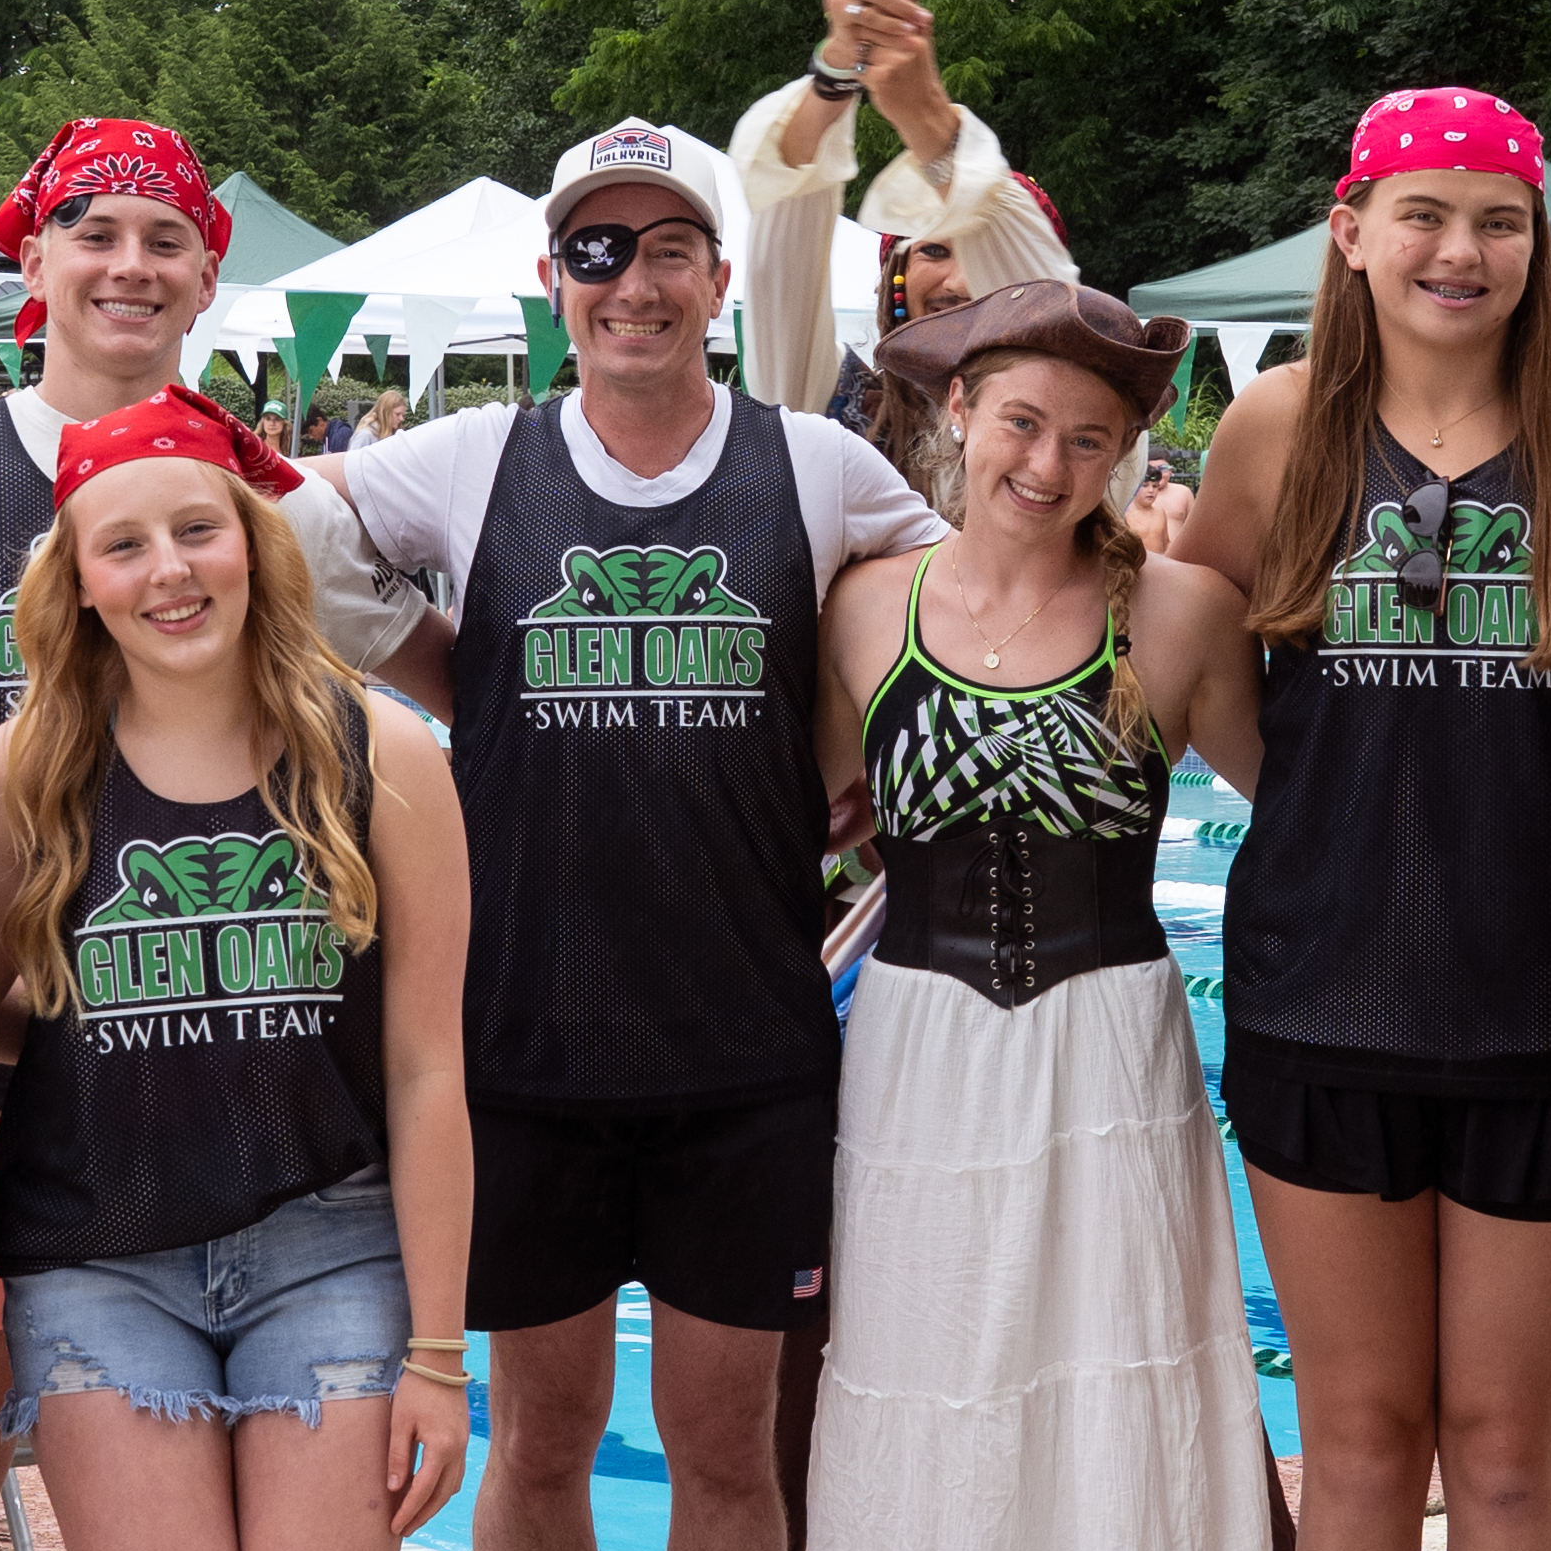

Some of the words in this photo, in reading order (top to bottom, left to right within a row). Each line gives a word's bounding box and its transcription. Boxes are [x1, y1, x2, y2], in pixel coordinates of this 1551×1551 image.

[596, 149, 666, 166] VALKYRIES
[1323, 583, 1434, 645] GLEN
[1447, 583, 1541, 645] OAK
[525, 627, 632, 688] GLEN
[644, 626, 765, 686] OAKS
[1333, 657, 1439, 687] SWIM
[536, 700, 638, 729] SWIM
[650, 700, 747, 727] TEAM
[78, 928, 206, 1007] GLEN
[216, 922, 347, 994] OAKS
[98, 1012, 214, 1054] SWIM
[227, 1005, 323, 1043] TEAM
